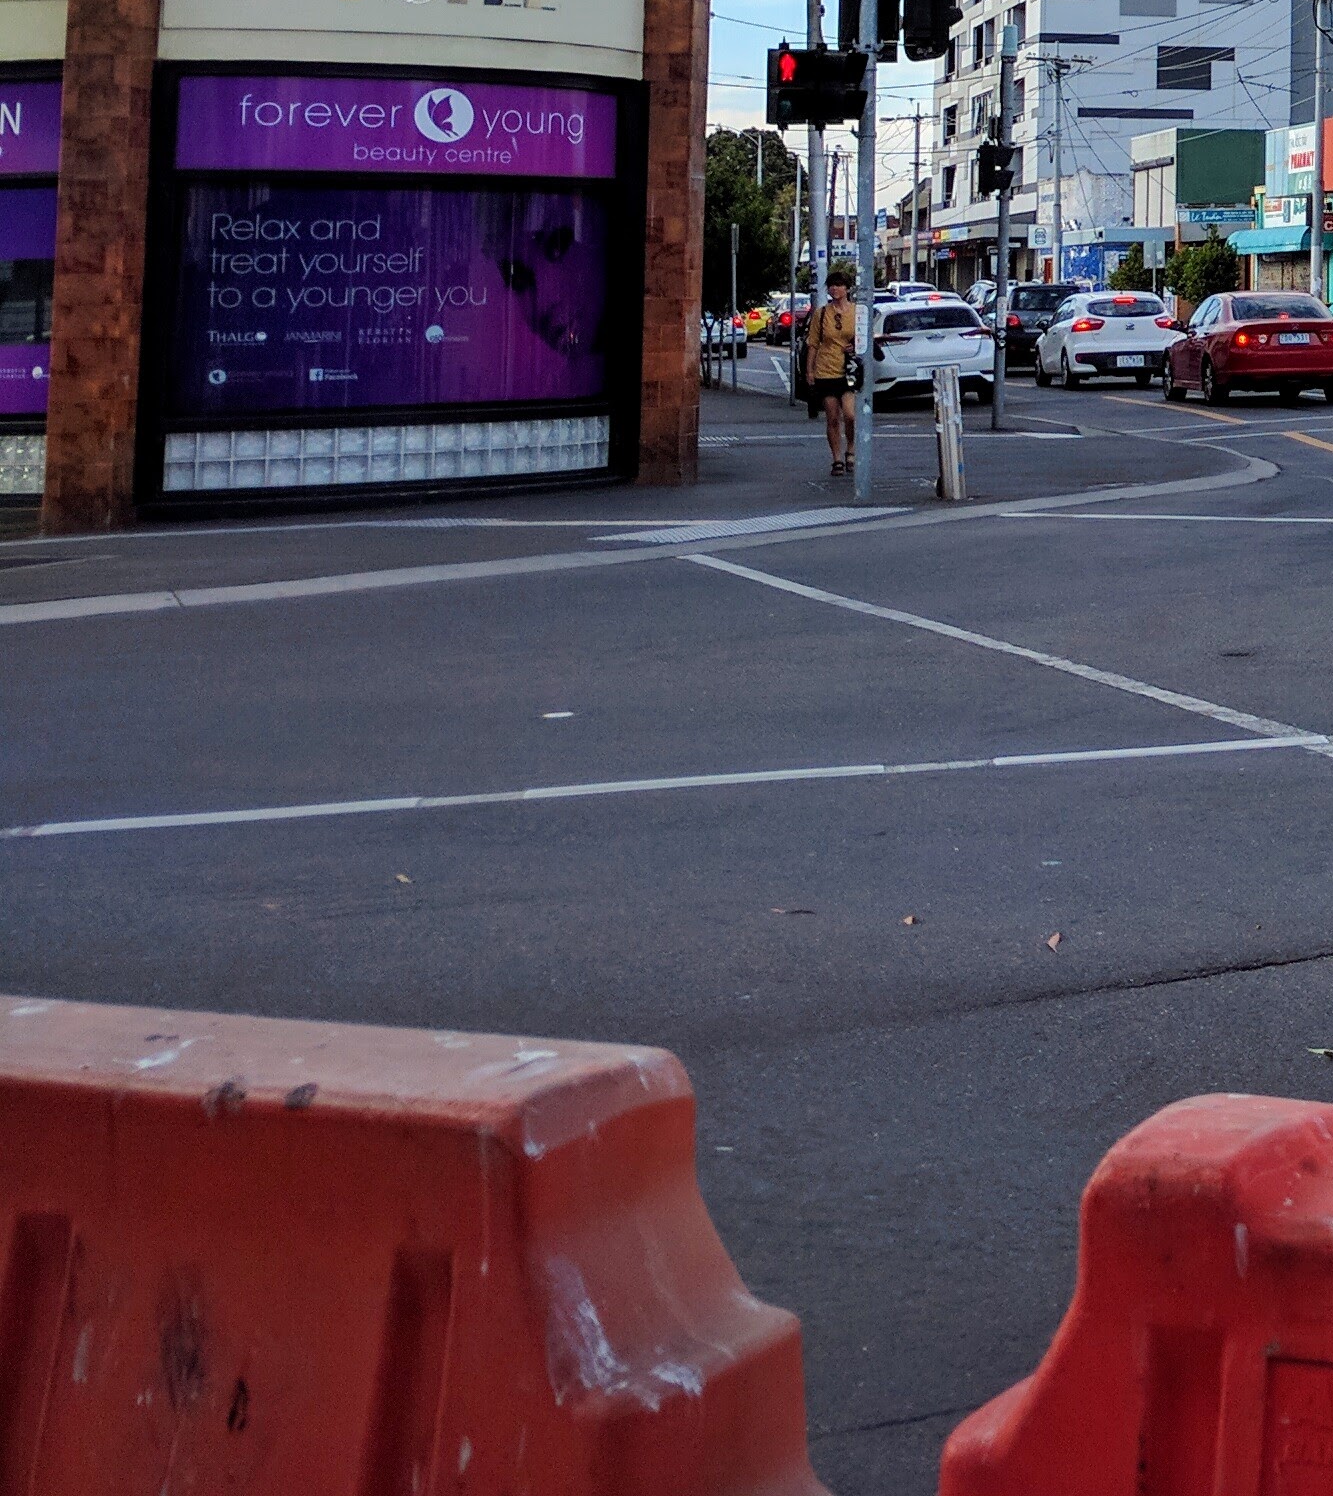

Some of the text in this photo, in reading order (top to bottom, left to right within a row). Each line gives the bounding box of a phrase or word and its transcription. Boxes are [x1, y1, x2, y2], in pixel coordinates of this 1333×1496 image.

[239, 93, 585, 144] forever young
[354, 143, 513, 165] beauty centre
[211, 213, 381, 242] Relax and
[209, 247, 424, 280] treat yourself
[207, 281, 488, 314] to a younger you
